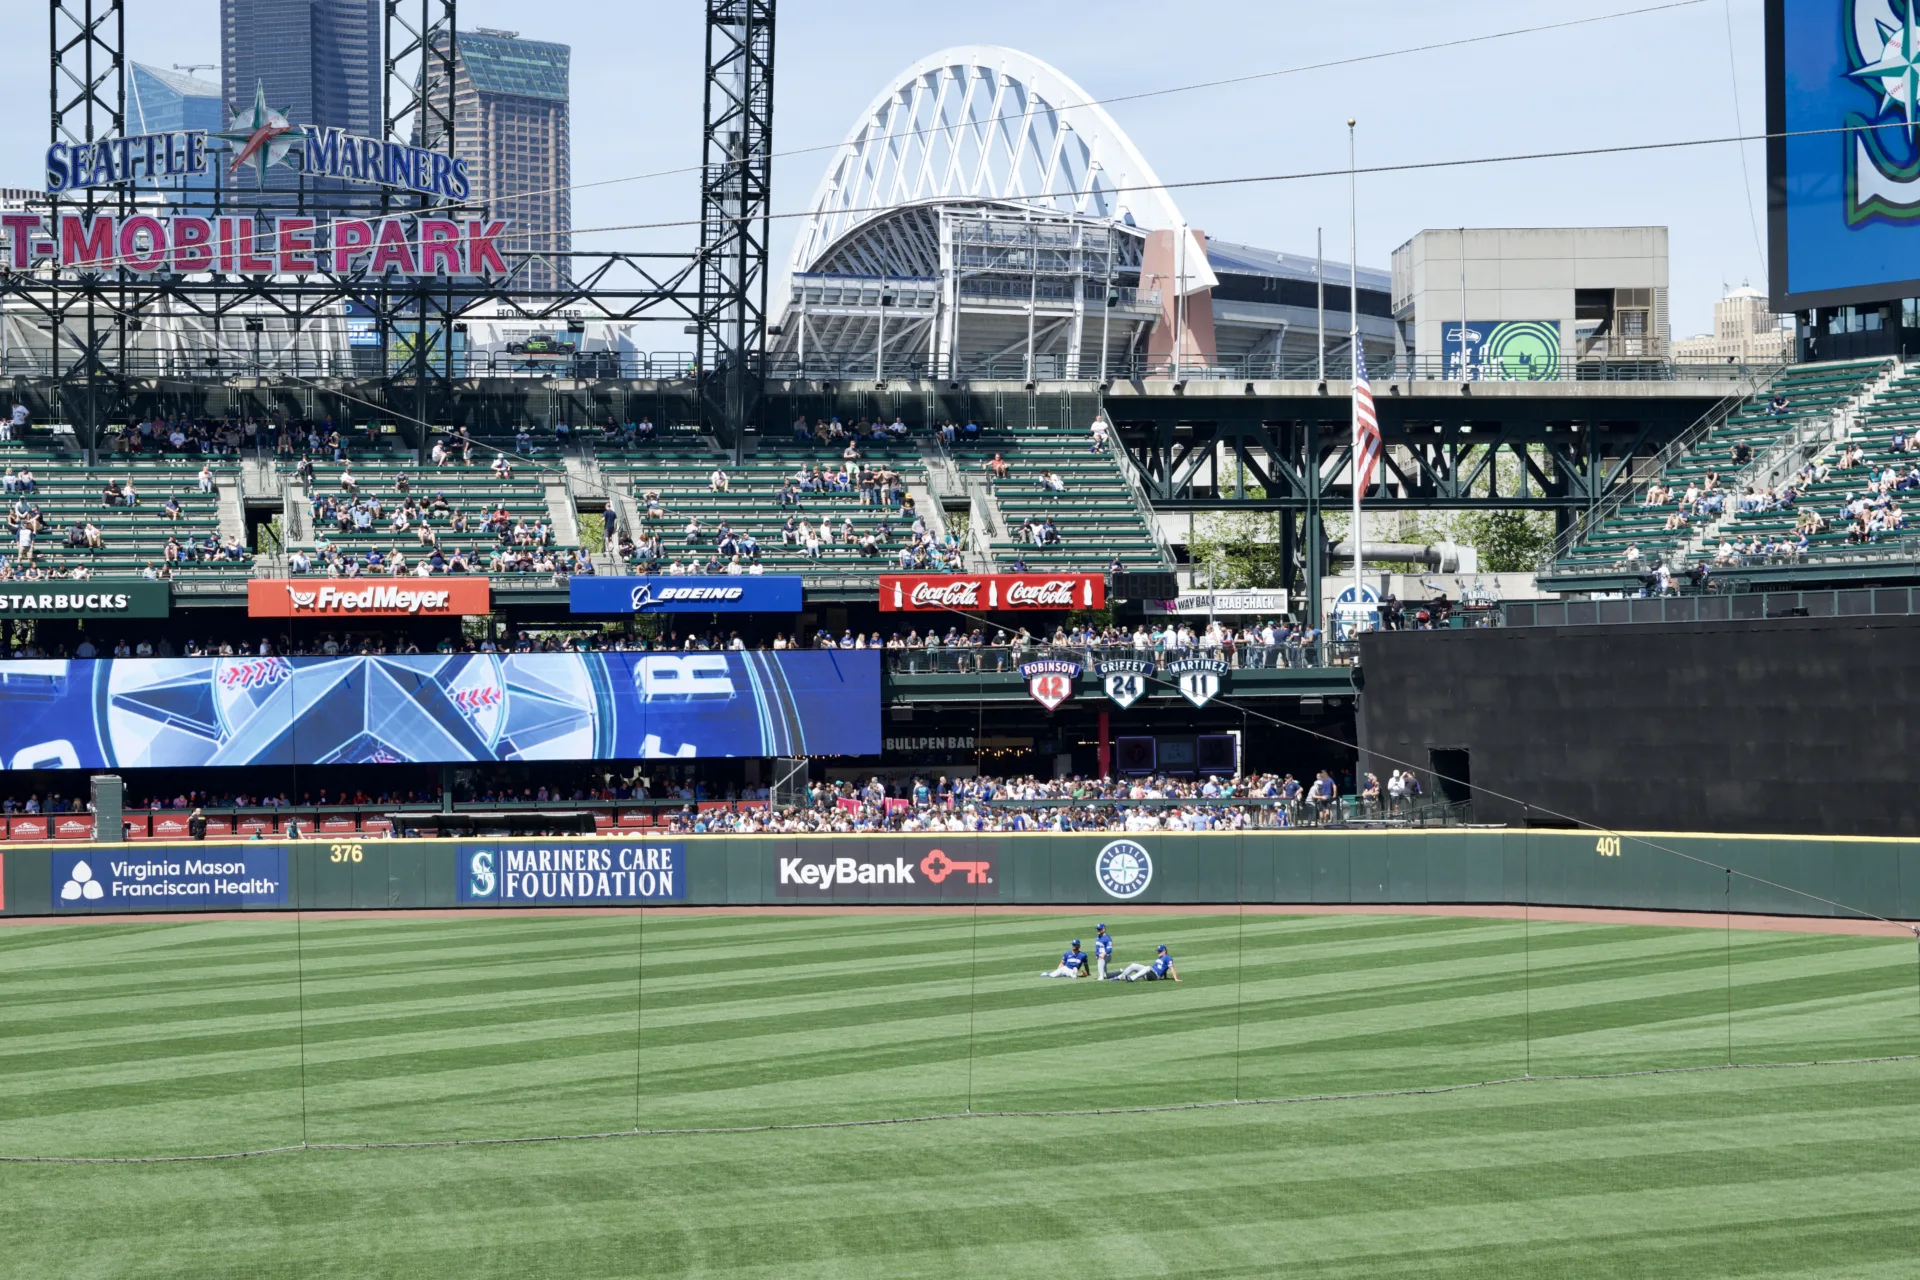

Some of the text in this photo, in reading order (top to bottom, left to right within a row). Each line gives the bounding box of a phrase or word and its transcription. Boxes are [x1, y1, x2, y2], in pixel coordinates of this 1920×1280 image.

[45, 129, 208, 194] SEATTLE
[299, 124, 471, 202] MARINERS
[0, 213, 512, 276] T-MOBILE PARK
[0, 594, 128, 608] STARBUCKS
[657, 588, 743, 599] BOEING
[911, 581, 980, 606] Coca-Cola
[1006, 581, 1076, 605] Coca-Cola
[1177, 597, 1195, 610] WAY
[1217, 596, 1241, 610] CRAB
[1244, 596, 1275, 609] SHACK
[1024, 661, 1075, 675] ROBINSON
[1101, 660, 1146, 673] GRIFFEY
[1172, 659, 1226, 673] MARTINEZ
[1037, 676, 1063, 697] 42
[1113, 675, 1136, 696] 24
[1190, 674, 1208, 697] 11
[886, 736, 975, 750] BULLPEN BAR
[330, 844, 363, 862] 376
[1102, 845, 1145, 864] SEATTLE
[1596, 837, 1620, 856] 401
[507, 848, 673, 871] MARINERS CARE
[111, 860, 245, 881] Virginia Mason
[780, 857, 915, 889] KeyBank
[112, 880, 210, 897] Franciscan
[507, 871, 674, 897] FOUNDATION
[1102, 873, 1146, 893] MARINERS
